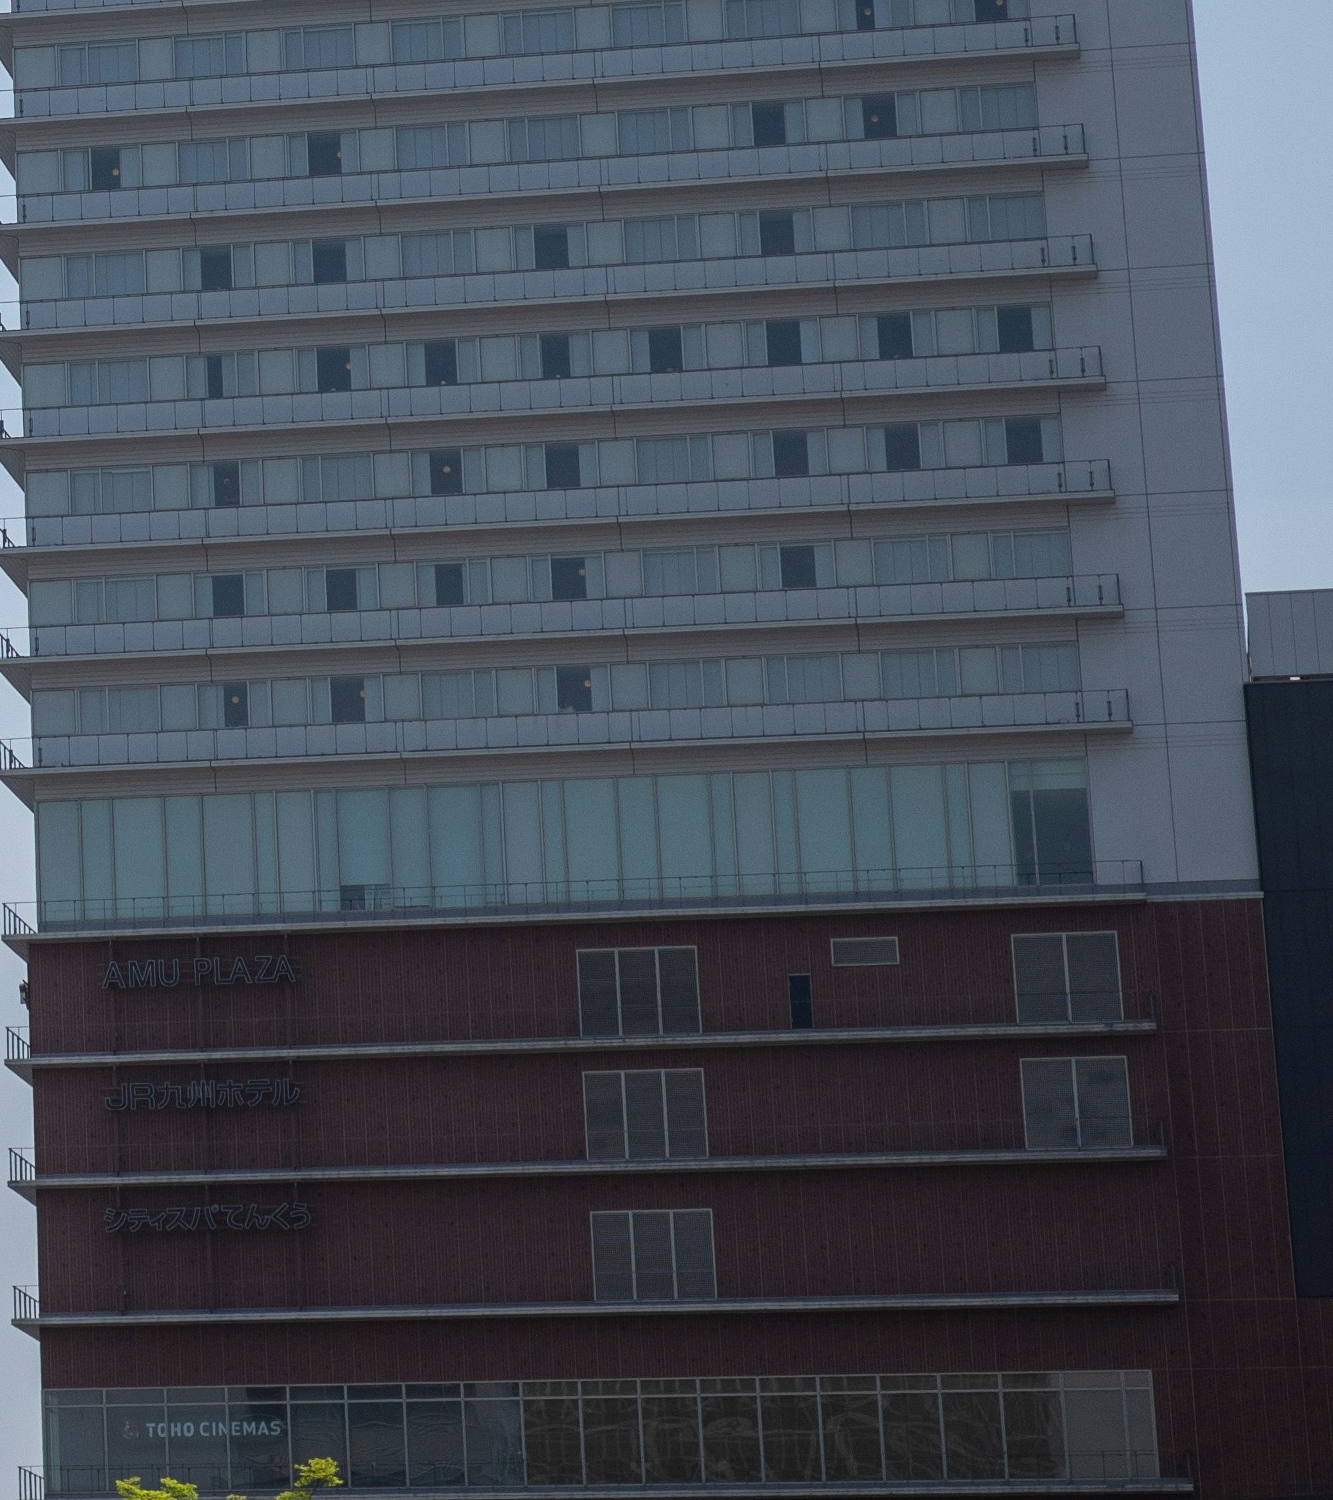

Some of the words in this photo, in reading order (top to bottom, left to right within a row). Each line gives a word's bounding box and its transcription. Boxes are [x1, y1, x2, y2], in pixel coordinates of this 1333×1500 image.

[102, 958, 180, 989] AMU
[193, 954, 295, 986] PLAZA
[104, 1078, 300, 1111] JR九州ホテル
[146, 1422, 195, 1438] TOHO
[199, 1420, 282, 1437] CINEMAS
